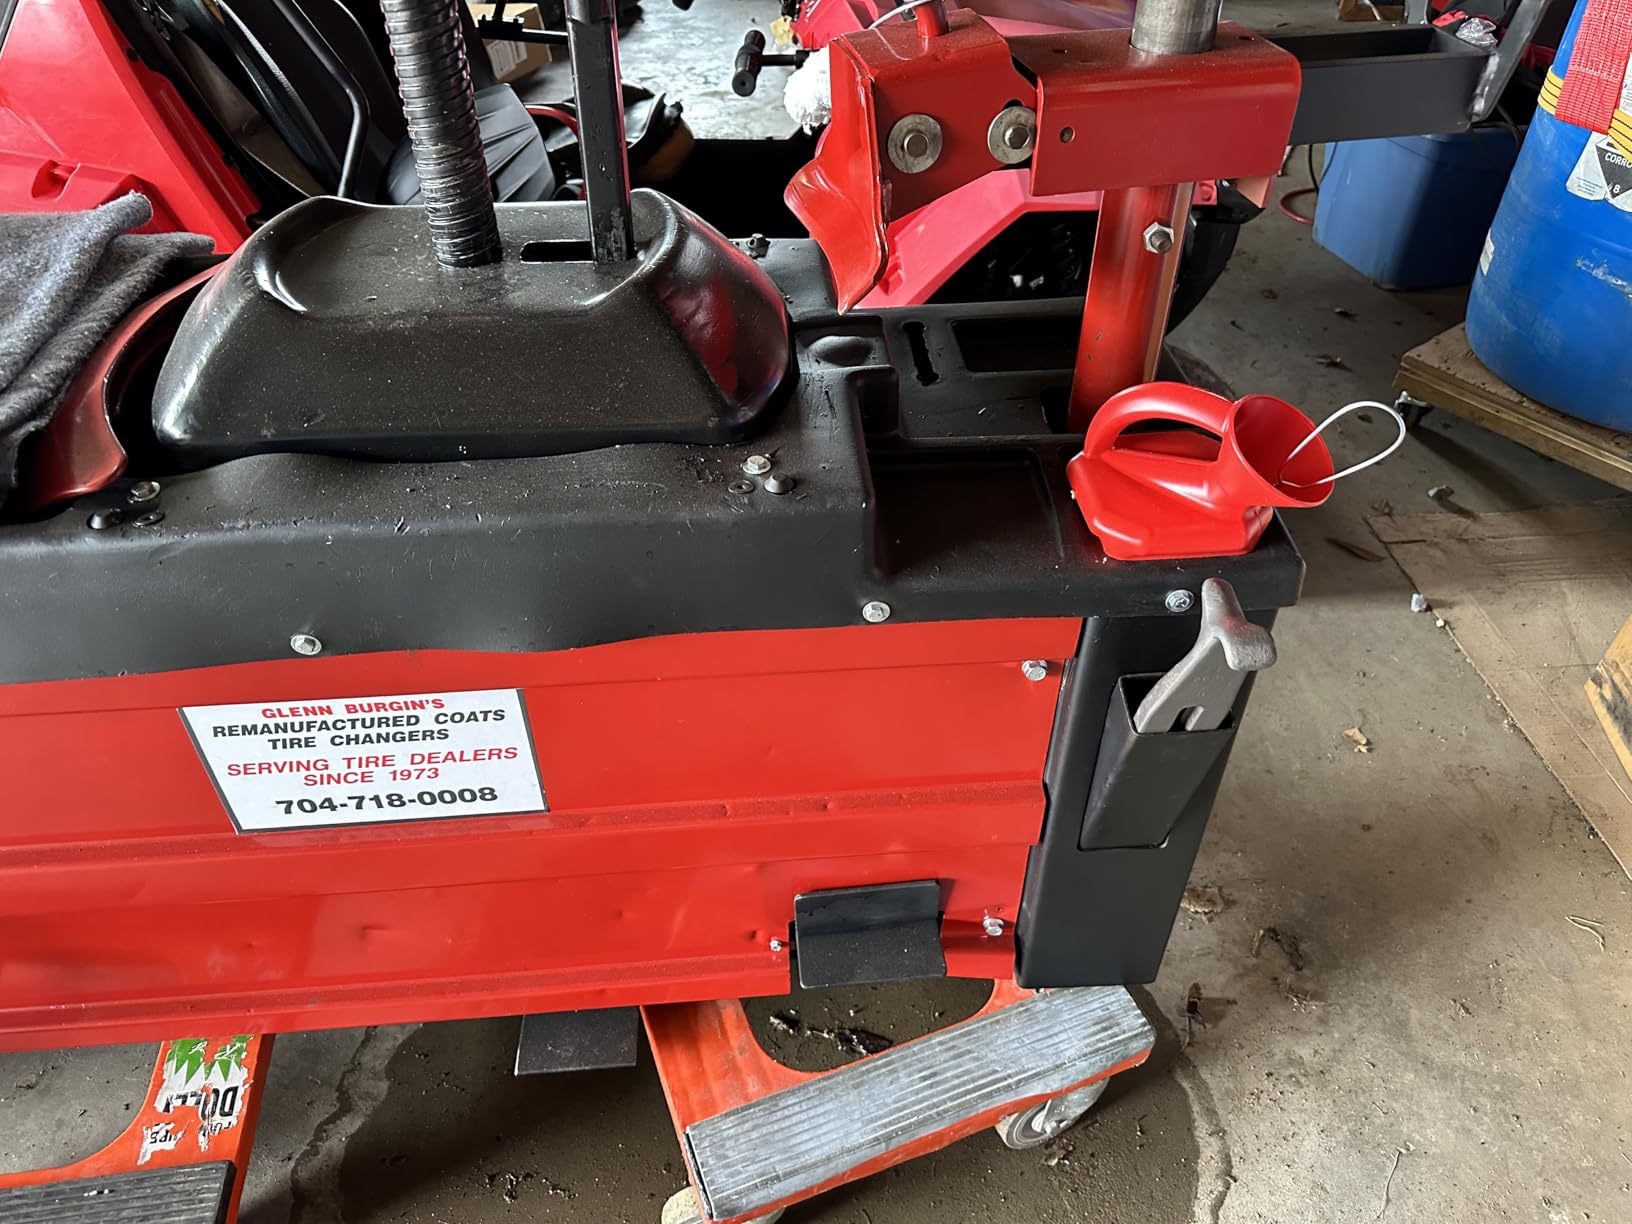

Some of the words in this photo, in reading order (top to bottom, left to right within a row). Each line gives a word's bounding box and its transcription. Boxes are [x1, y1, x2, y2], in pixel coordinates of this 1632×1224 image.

[1613, 183, 1621, 194] 8
[261, 705, 333, 719] GLENN
[345, 698, 446, 714] BURGIN'S
[212, 714, 421, 737] REMANUFACTURED
[433, 709, 506, 725] COATS
[267, 736, 317, 750] TIRE
[329, 728, 450, 746] CHANGERS
[227, 758, 330, 776] SERVING
[342, 754, 396, 769] TIRE
[409, 747, 519, 766] DEALERS
[303, 771, 375, 786] SINCE
[388, 767, 440, 781] 1973
[275, 786, 498, 814] 704-718-0008
